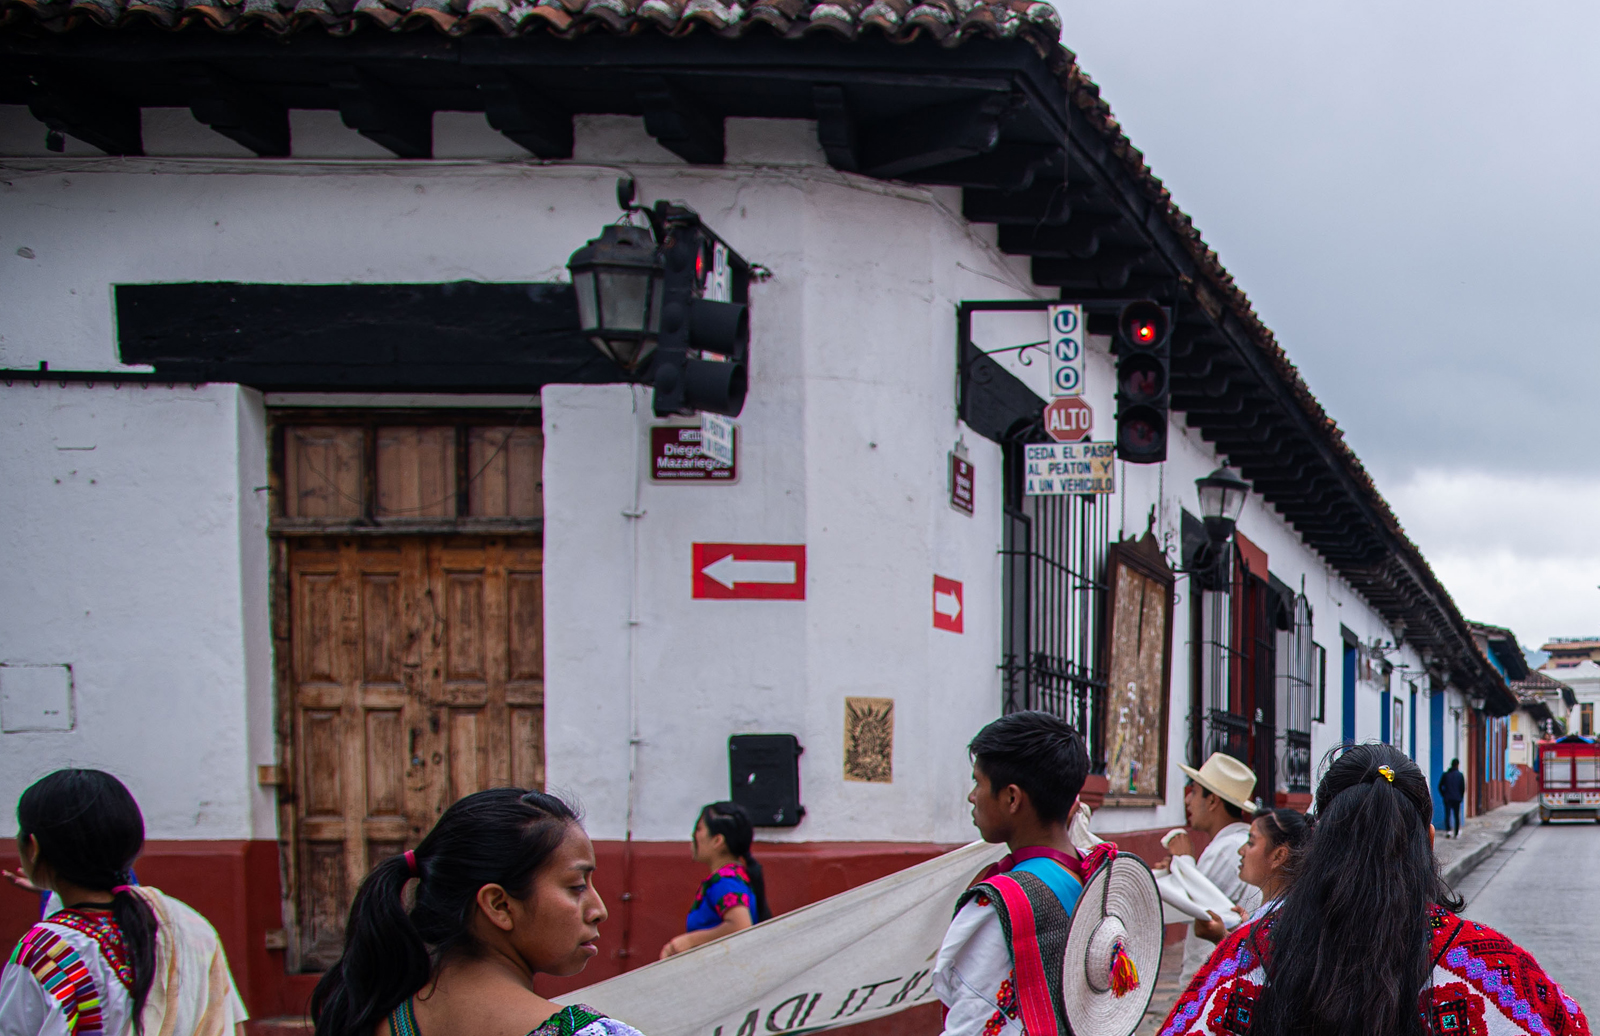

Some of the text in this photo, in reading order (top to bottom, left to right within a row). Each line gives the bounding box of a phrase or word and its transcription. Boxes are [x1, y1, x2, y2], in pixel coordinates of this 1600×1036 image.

[1056, 312, 1077, 388] UNO
[1050, 408, 1090, 431] ALTO
[664, 443, 703, 458] Diego
[1027, 444, 1111, 460] CEDA EL PASO
[1028, 461, 1111, 475] AL PEATON Y
[1027, 478, 1112, 492] A UN VEHICULO
